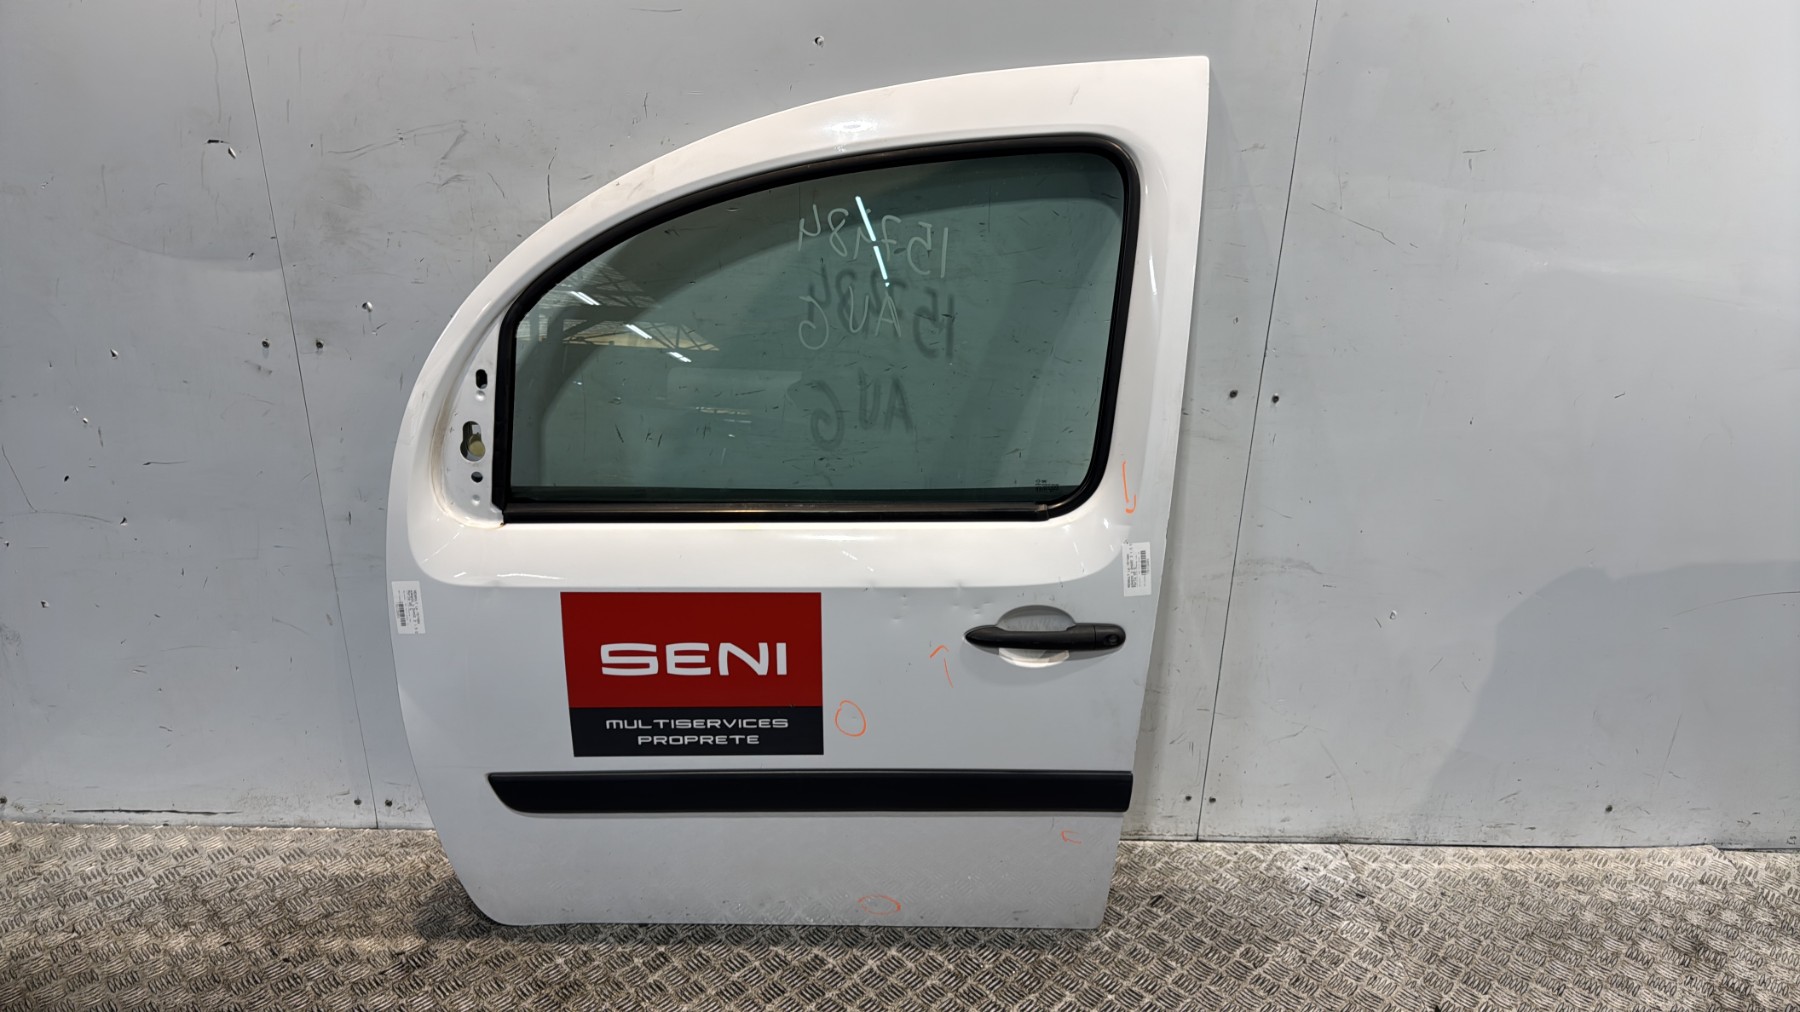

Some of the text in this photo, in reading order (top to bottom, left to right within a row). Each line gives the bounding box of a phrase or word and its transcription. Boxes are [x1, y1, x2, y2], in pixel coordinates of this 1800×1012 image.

[600, 642, 787, 676] SENI
[605, 718, 789, 729] MULTISERVICES
[637, 735, 760, 745] PROPRETE
